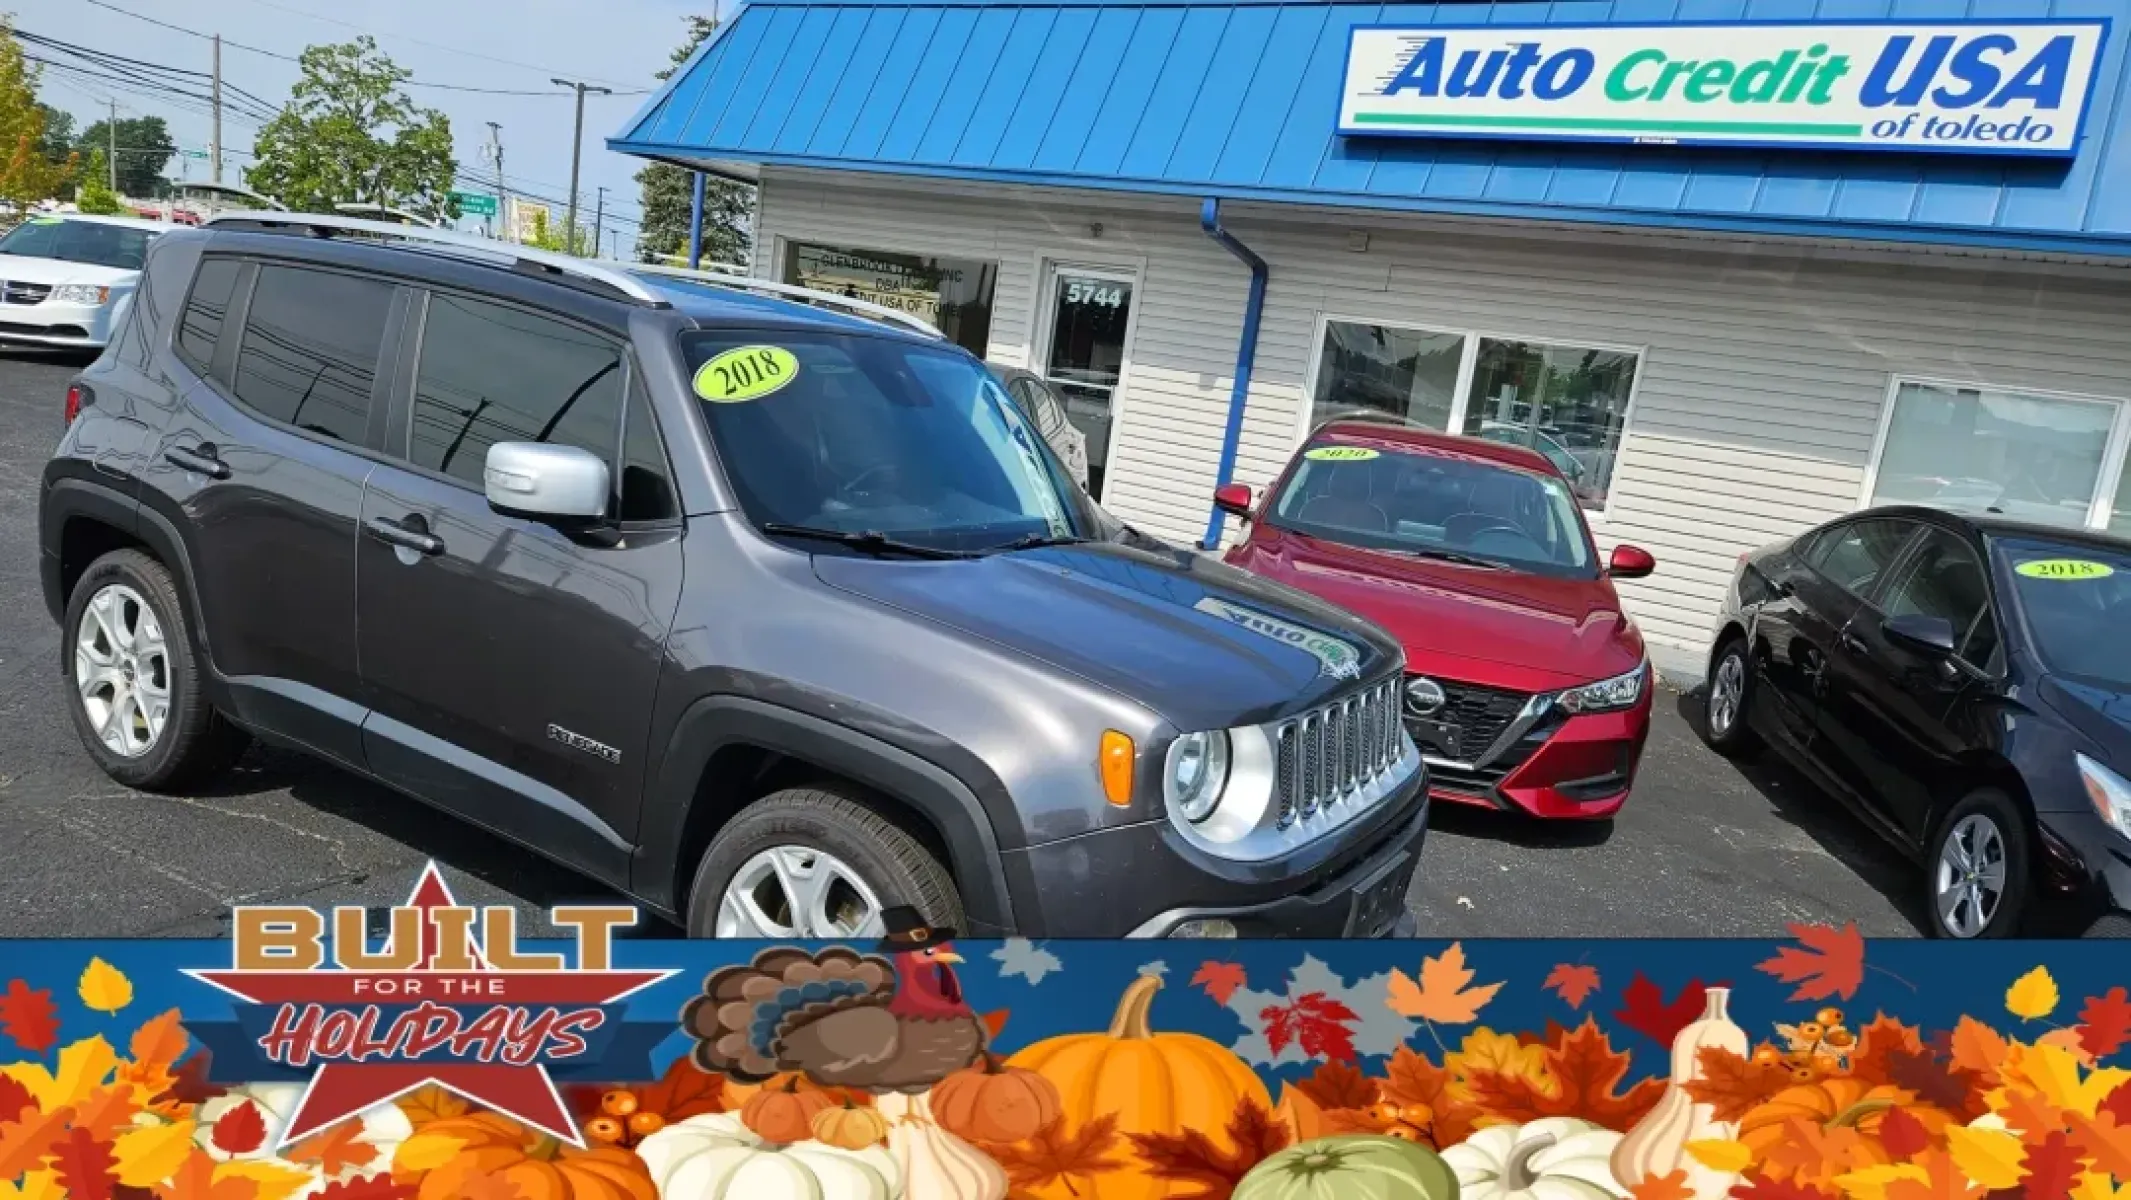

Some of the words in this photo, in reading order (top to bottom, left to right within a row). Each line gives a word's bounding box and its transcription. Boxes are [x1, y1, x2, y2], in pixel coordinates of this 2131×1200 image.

[1380, 37, 1595, 101] Auto
[1604, 42, 1851, 105] Credit
[1858, 33, 2076, 110] USA
[1870, 112, 1920, 139] of
[1921, 114, 2054, 143] toledo
[1065, 283, 1121, 308] 5744
[714, 350, 781, 396] 2018
[2035, 563, 2095, 576] 2018
